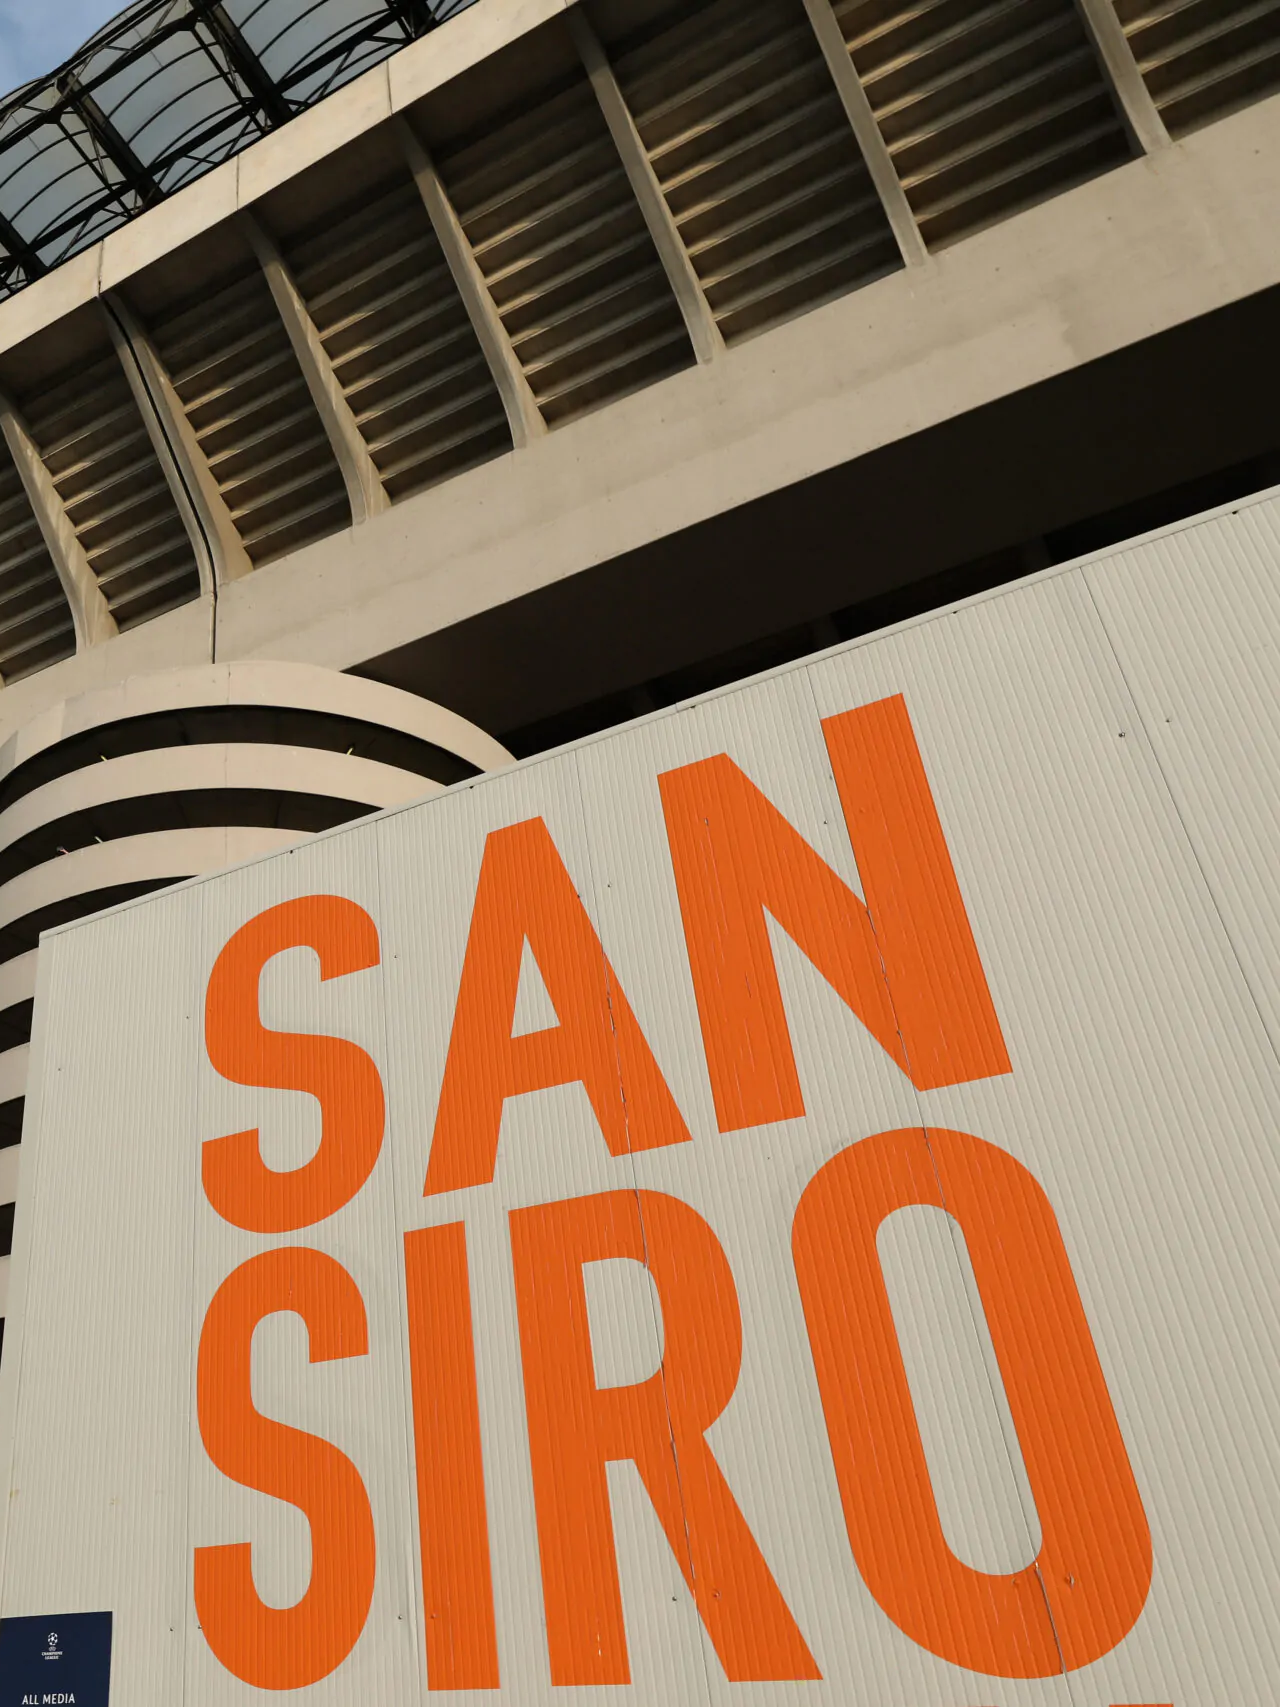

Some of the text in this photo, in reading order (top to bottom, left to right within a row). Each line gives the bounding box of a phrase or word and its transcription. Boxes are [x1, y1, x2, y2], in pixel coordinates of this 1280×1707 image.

[201, 693, 1013, 1234] SAN
[193, 1128, 1153, 1691] SIRO
[21, 1692, 76, 1705] ALL MEDIA
